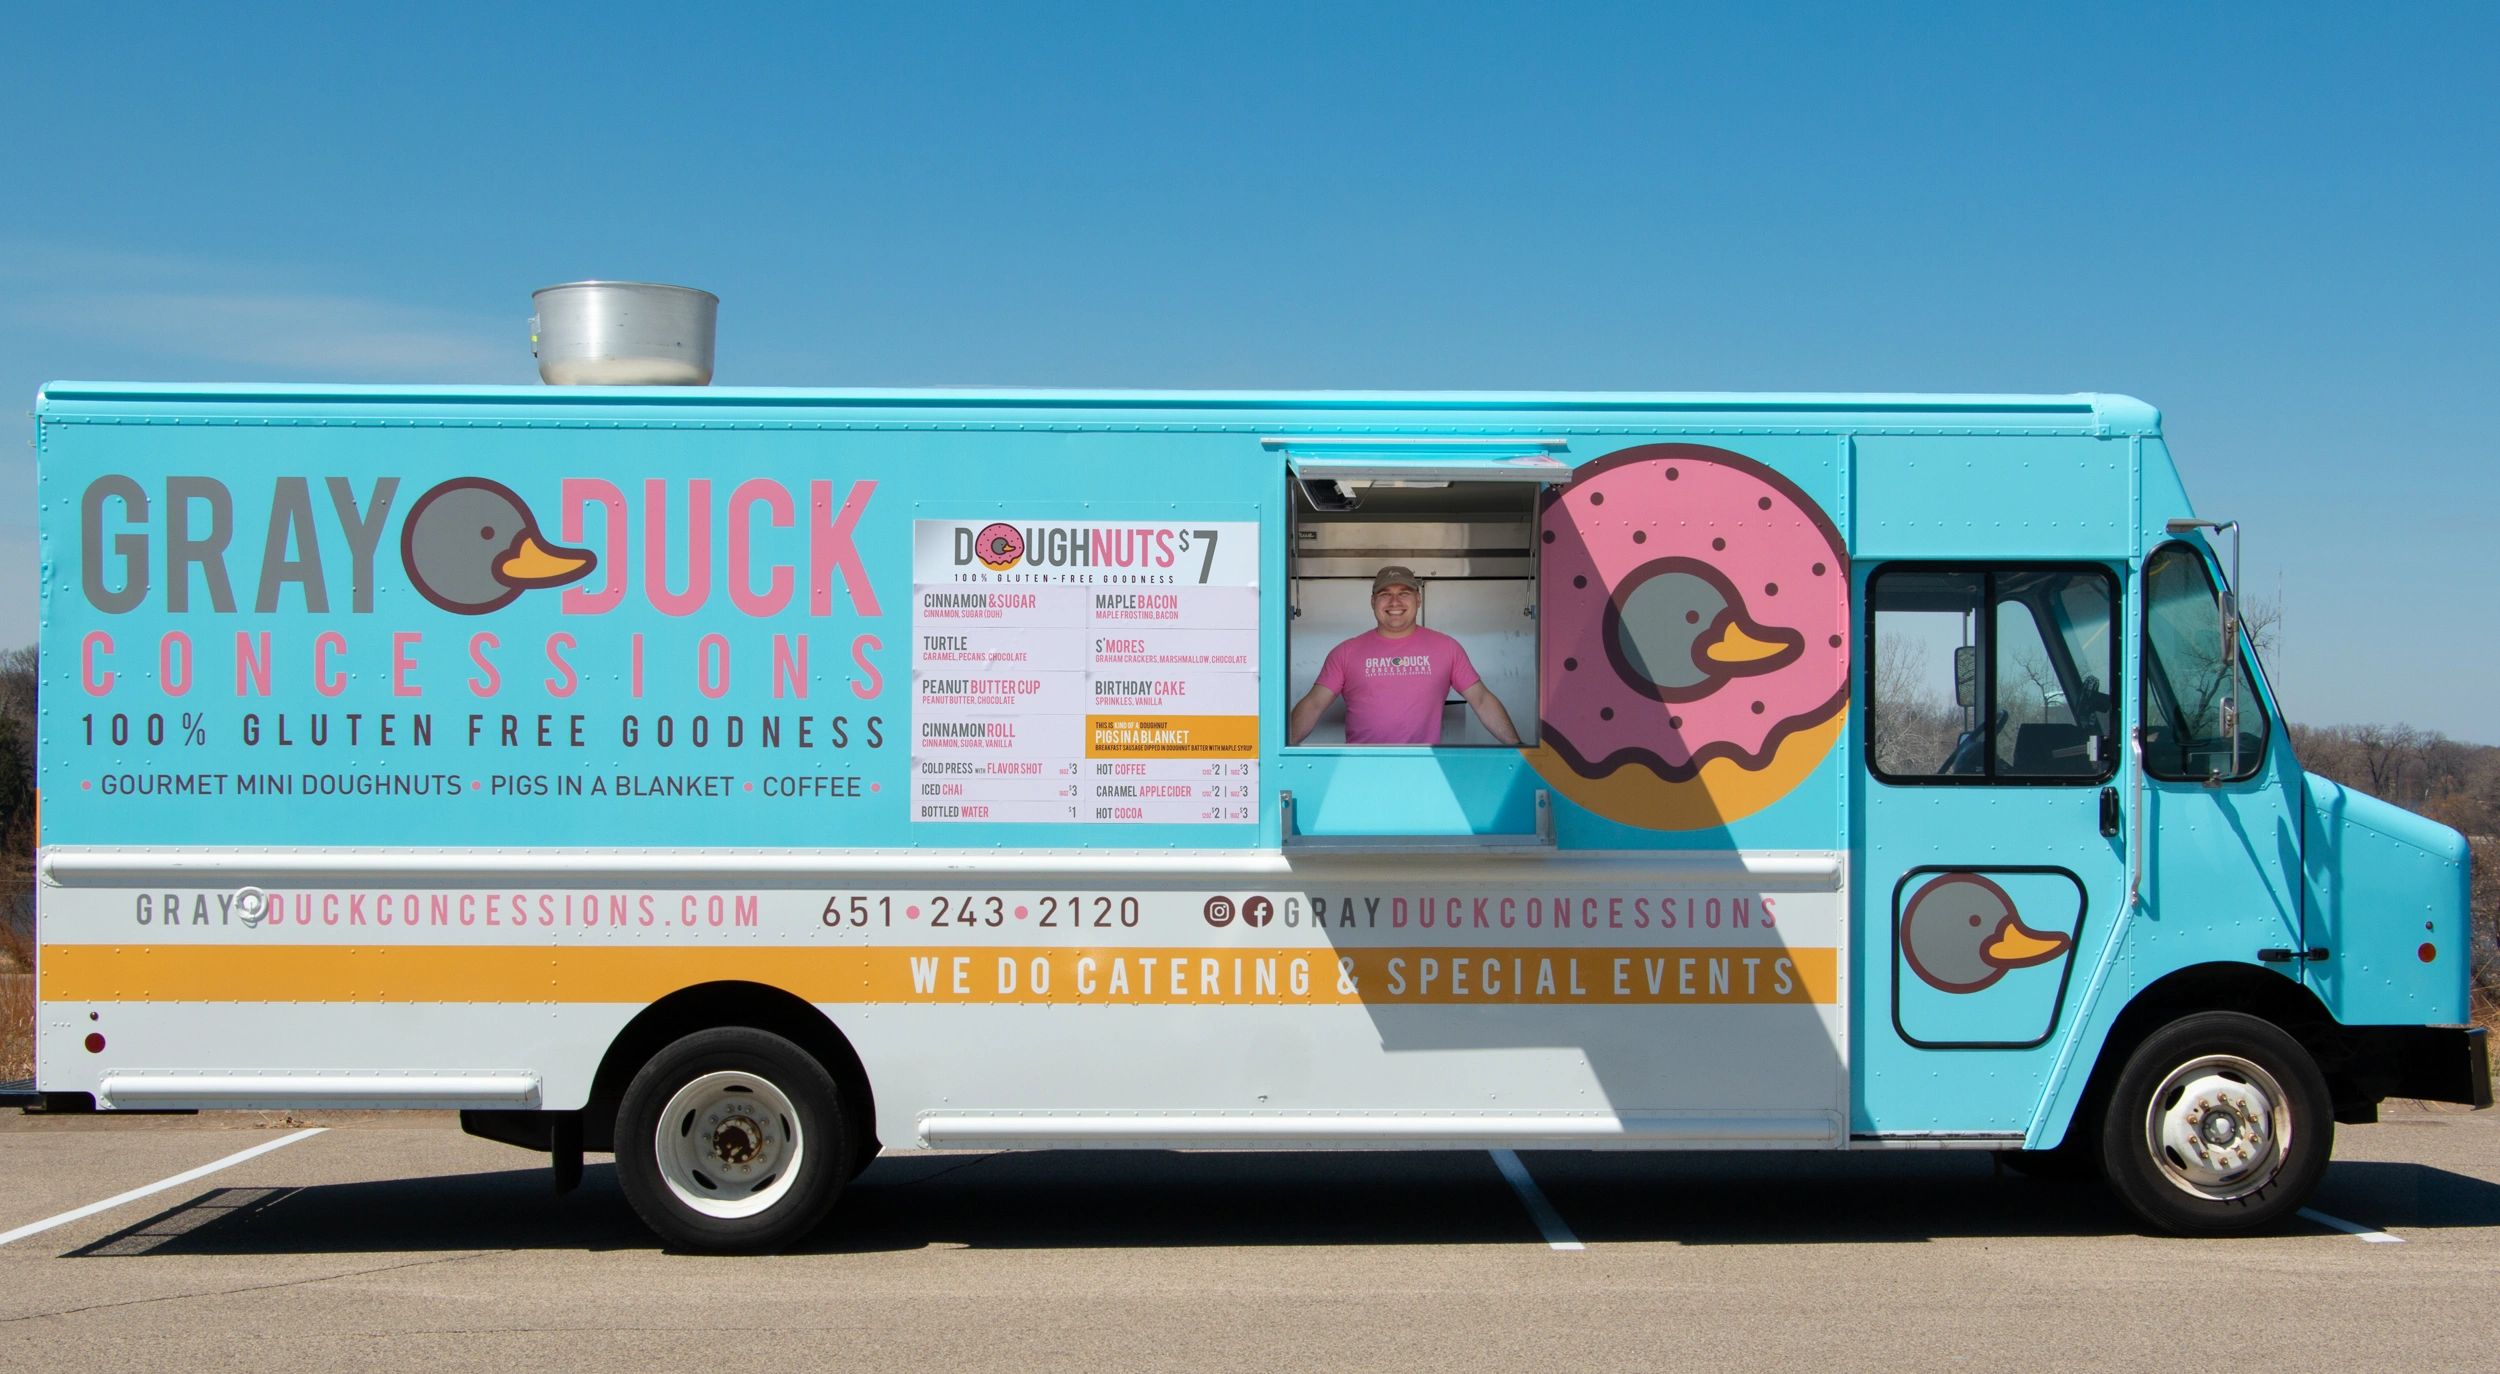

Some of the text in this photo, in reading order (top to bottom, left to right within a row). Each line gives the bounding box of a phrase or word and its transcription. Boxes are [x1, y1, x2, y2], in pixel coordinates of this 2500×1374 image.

[81, 473, 884, 618] GRAY DUCK
[954, 574, 1175, 583] 100% GLUTEN-FREE GOODNESS
[925, 594, 986, 608] CINNAMON
[1096, 595, 1177, 609] MAPLE BACON
[962, 610, 983, 618] SUGAR
[1156, 611, 1178, 619] BACON
[924, 636, 967, 650] TURTLE
[1096, 638, 1144, 653] S'MORES
[989, 653, 1027, 661] CHOCOLATE
[1096, 655, 1123, 663] GRAHAM
[1366, 656, 1430, 668] GRAY DUCK
[81, 630, 883, 699] CONCESSIONS
[923, 680, 1040, 694] PEANUT BUTTER CUP
[1096, 681, 1185, 695] BIRTHDAY CAKE
[923, 696, 948, 704] PEANUT
[978, 696, 1015, 704] CHOCOLATE
[1136, 698, 1162, 706] VANILLA
[82, 712, 884, 748] 100% GLUTEN FREE GOODNESS
[923, 723, 1015, 737] CINNAMON ROLL
[1096, 731, 1189, 744] PIGS IN A BLANKET
[985, 740, 1012, 748] VANILLA
[922, 763, 943, 774] COLD
[946, 763, 973, 774] PRESS
[987, 763, 1019, 774] FLAVOR
[1021, 763, 1043, 774] SHOT
[1097, 764, 1113, 775] HOT
[1115, 764, 1146, 775] COFFEE
[101, 774, 861, 797] GOURMET MINI DOUGHNUTS PIGS IN A BLANKET COFFEE
[922, 784, 940, 795] ICED
[942, 784, 962, 795] CHAI
[1097, 786, 1137, 797] CARAMEL
[1140, 786, 1166, 797] APPLE
[1168, 786, 1191, 797] CIDER
[922, 807, 959, 817] BOTTLED
[961, 807, 988, 818] WATER
[1096, 808, 1113, 819] HOT
[1115, 808, 1142, 819] COCOA
[910, 956, 1793, 996] WE DO CATERING & SPECIAL EVENTS
